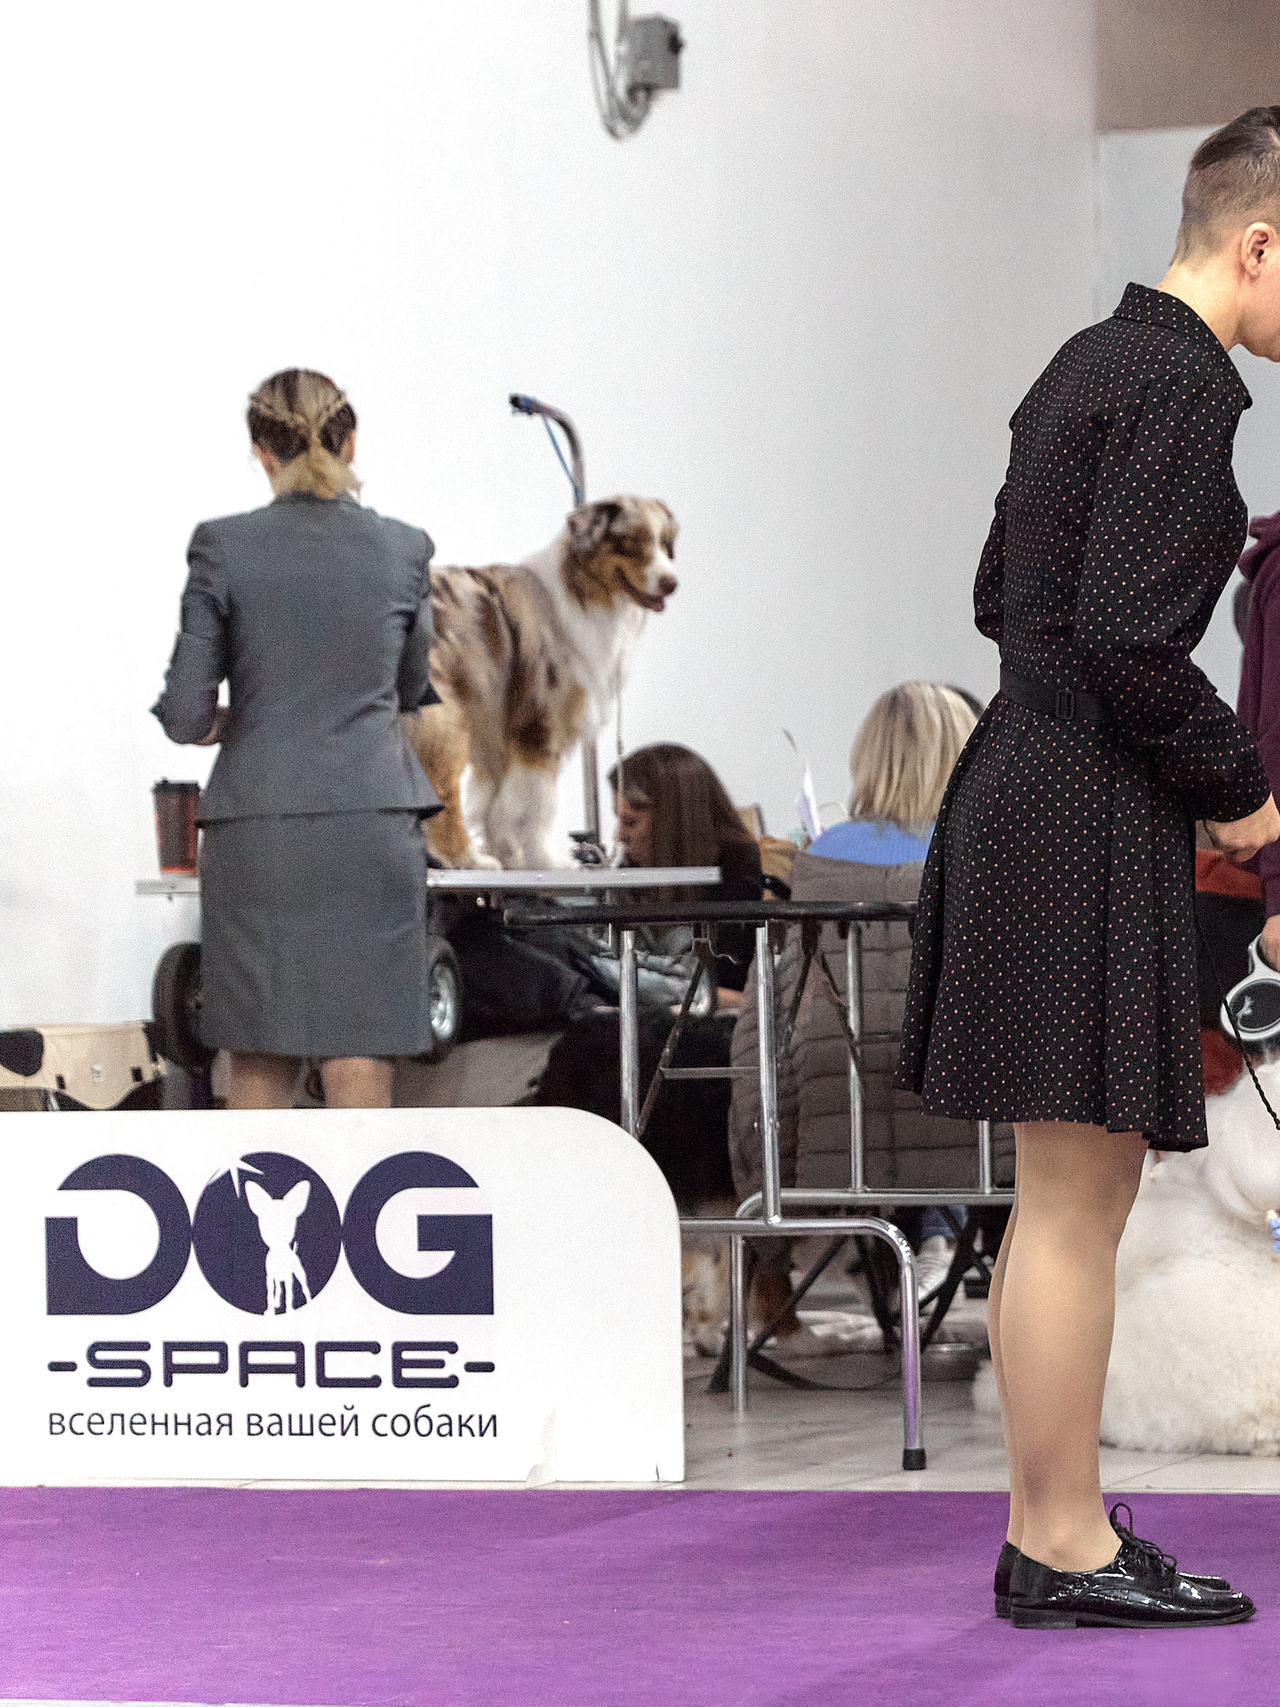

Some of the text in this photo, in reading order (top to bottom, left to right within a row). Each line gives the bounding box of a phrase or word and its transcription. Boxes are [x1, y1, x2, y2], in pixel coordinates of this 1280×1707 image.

[45, 1151, 495, 1316] DOG
[48, 1403, 498, 1438] вселенная вашей собаки
